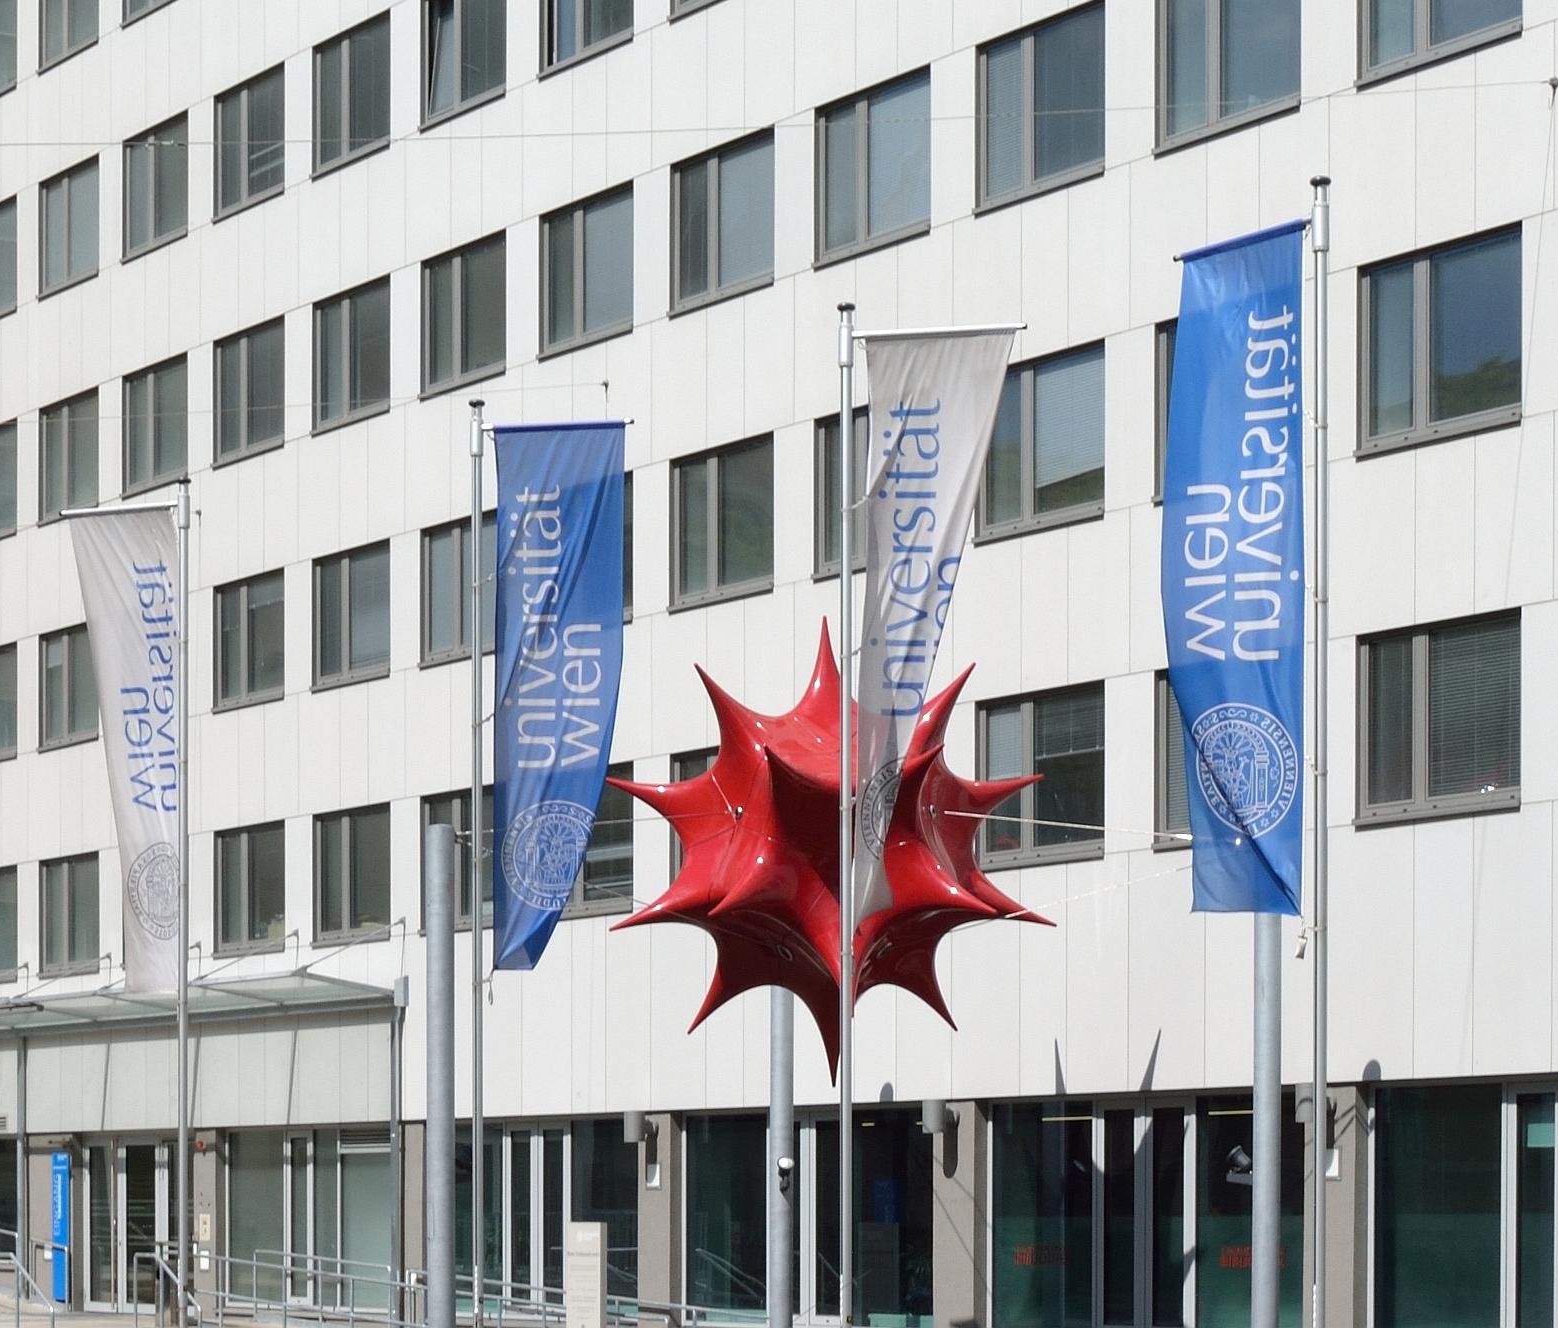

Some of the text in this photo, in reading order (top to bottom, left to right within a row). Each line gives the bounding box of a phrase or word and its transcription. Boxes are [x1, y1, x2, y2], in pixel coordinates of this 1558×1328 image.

[504, 483, 562, 770] universität
[561, 622, 602, 768] wien
[870, 397, 941, 717] universität
